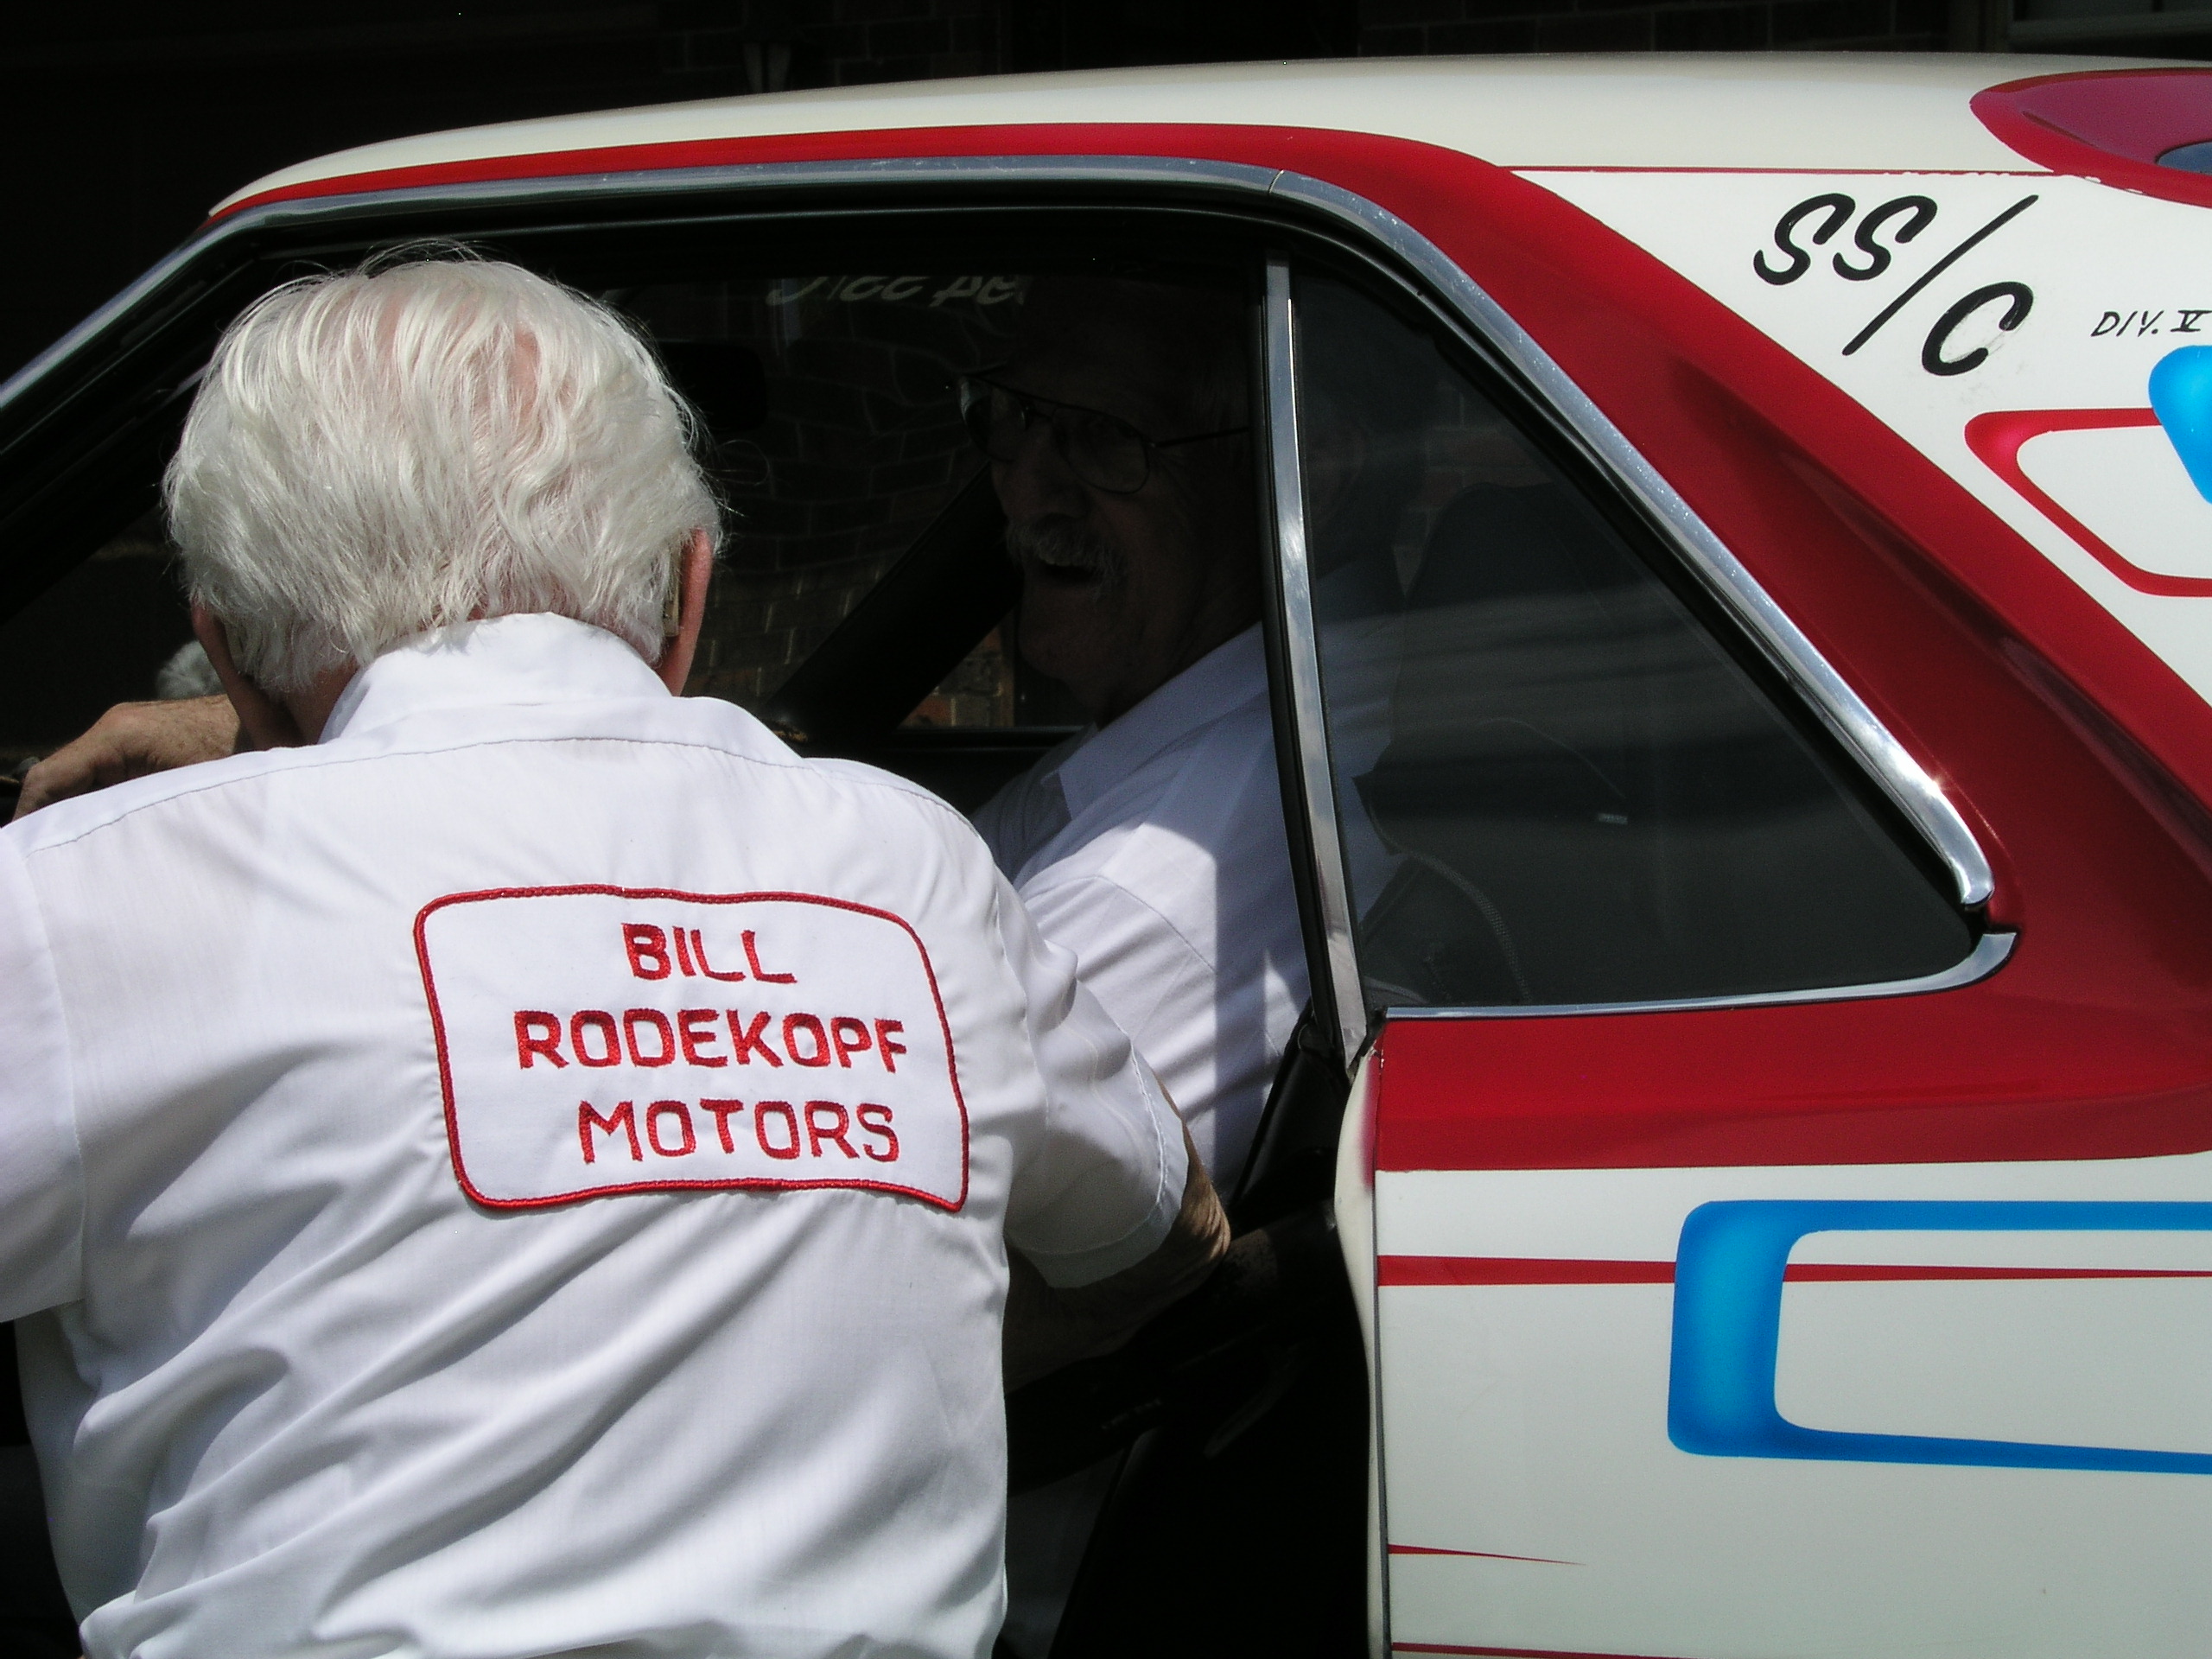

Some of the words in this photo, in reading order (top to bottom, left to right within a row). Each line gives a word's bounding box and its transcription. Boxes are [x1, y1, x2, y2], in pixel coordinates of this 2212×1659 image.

[1753, 193, 2039, 376] SS/C
[2090, 310, 2164, 337] DIV.
[621, 922, 797, 983] BILL
[513, 1007, 907, 1073] RODEKOPF
[577, 1098, 900, 1163] MOTORS
